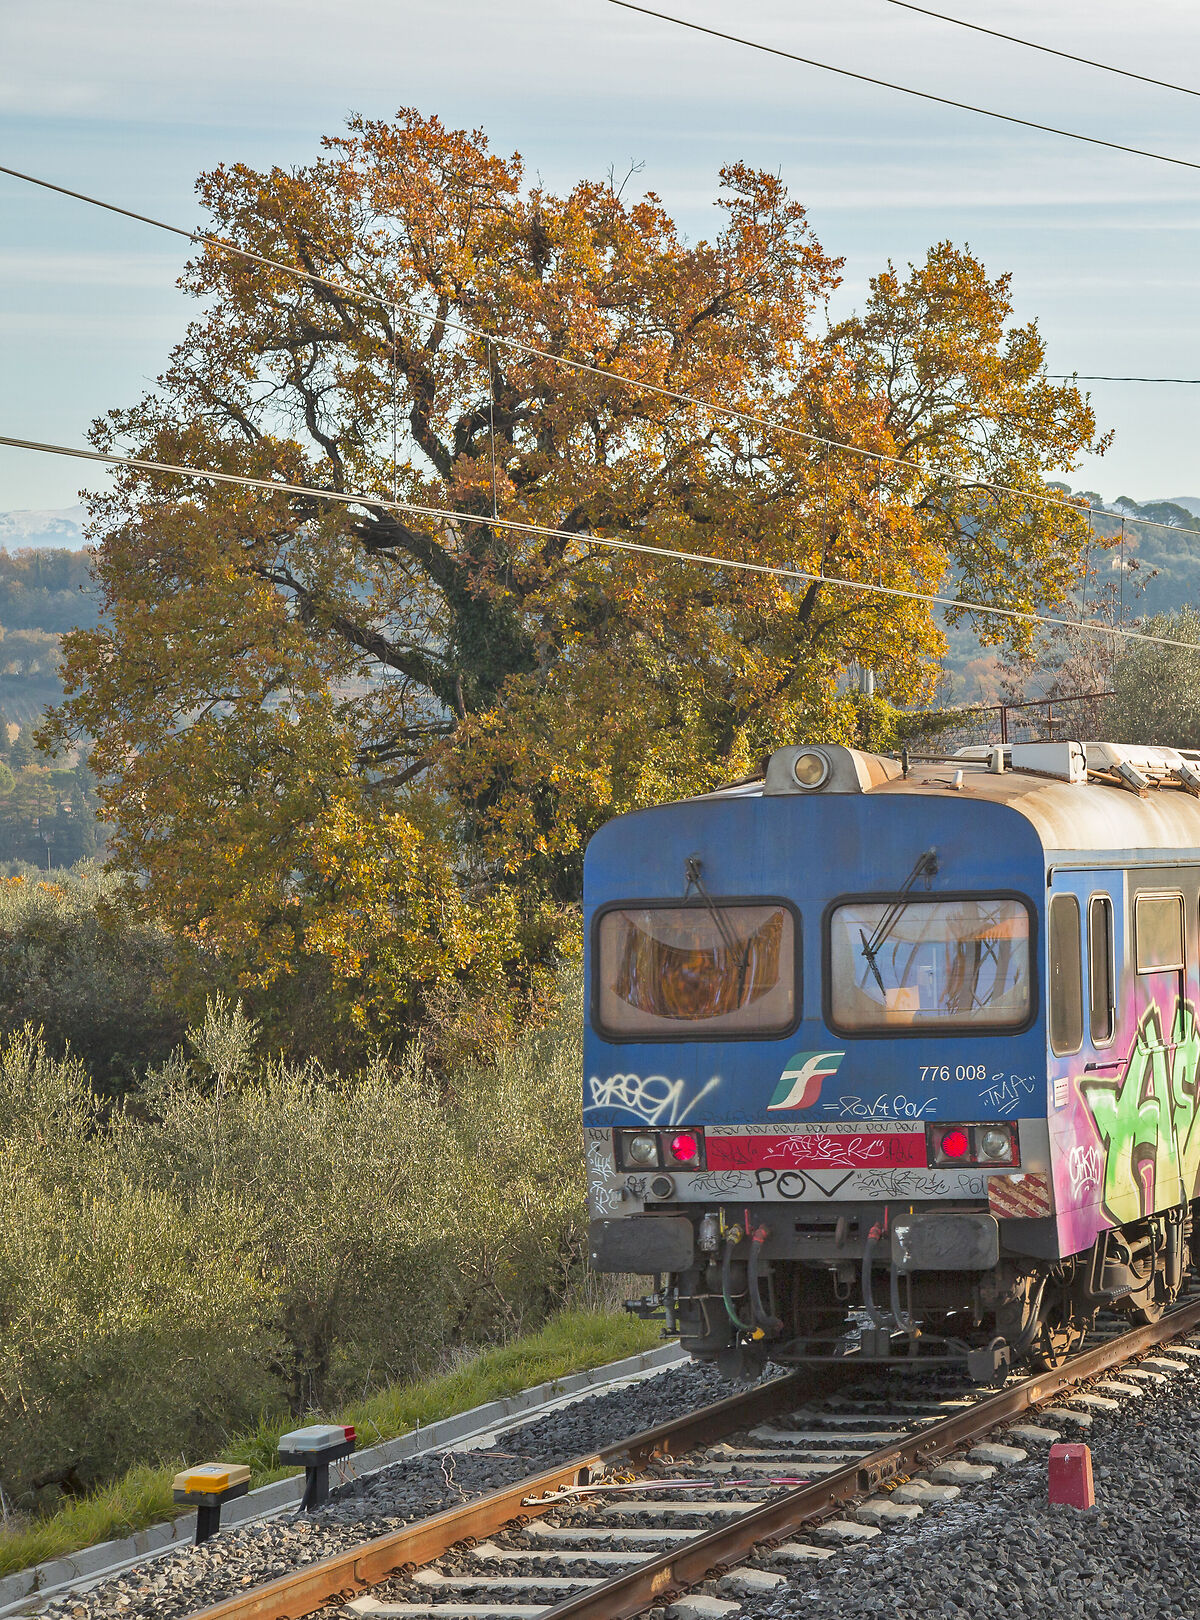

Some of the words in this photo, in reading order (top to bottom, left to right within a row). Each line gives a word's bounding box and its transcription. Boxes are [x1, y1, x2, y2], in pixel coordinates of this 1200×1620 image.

[919, 1066, 950, 1081] 776
[955, 1065, 986, 1081] 008
[755, 1167, 855, 1199] POV
